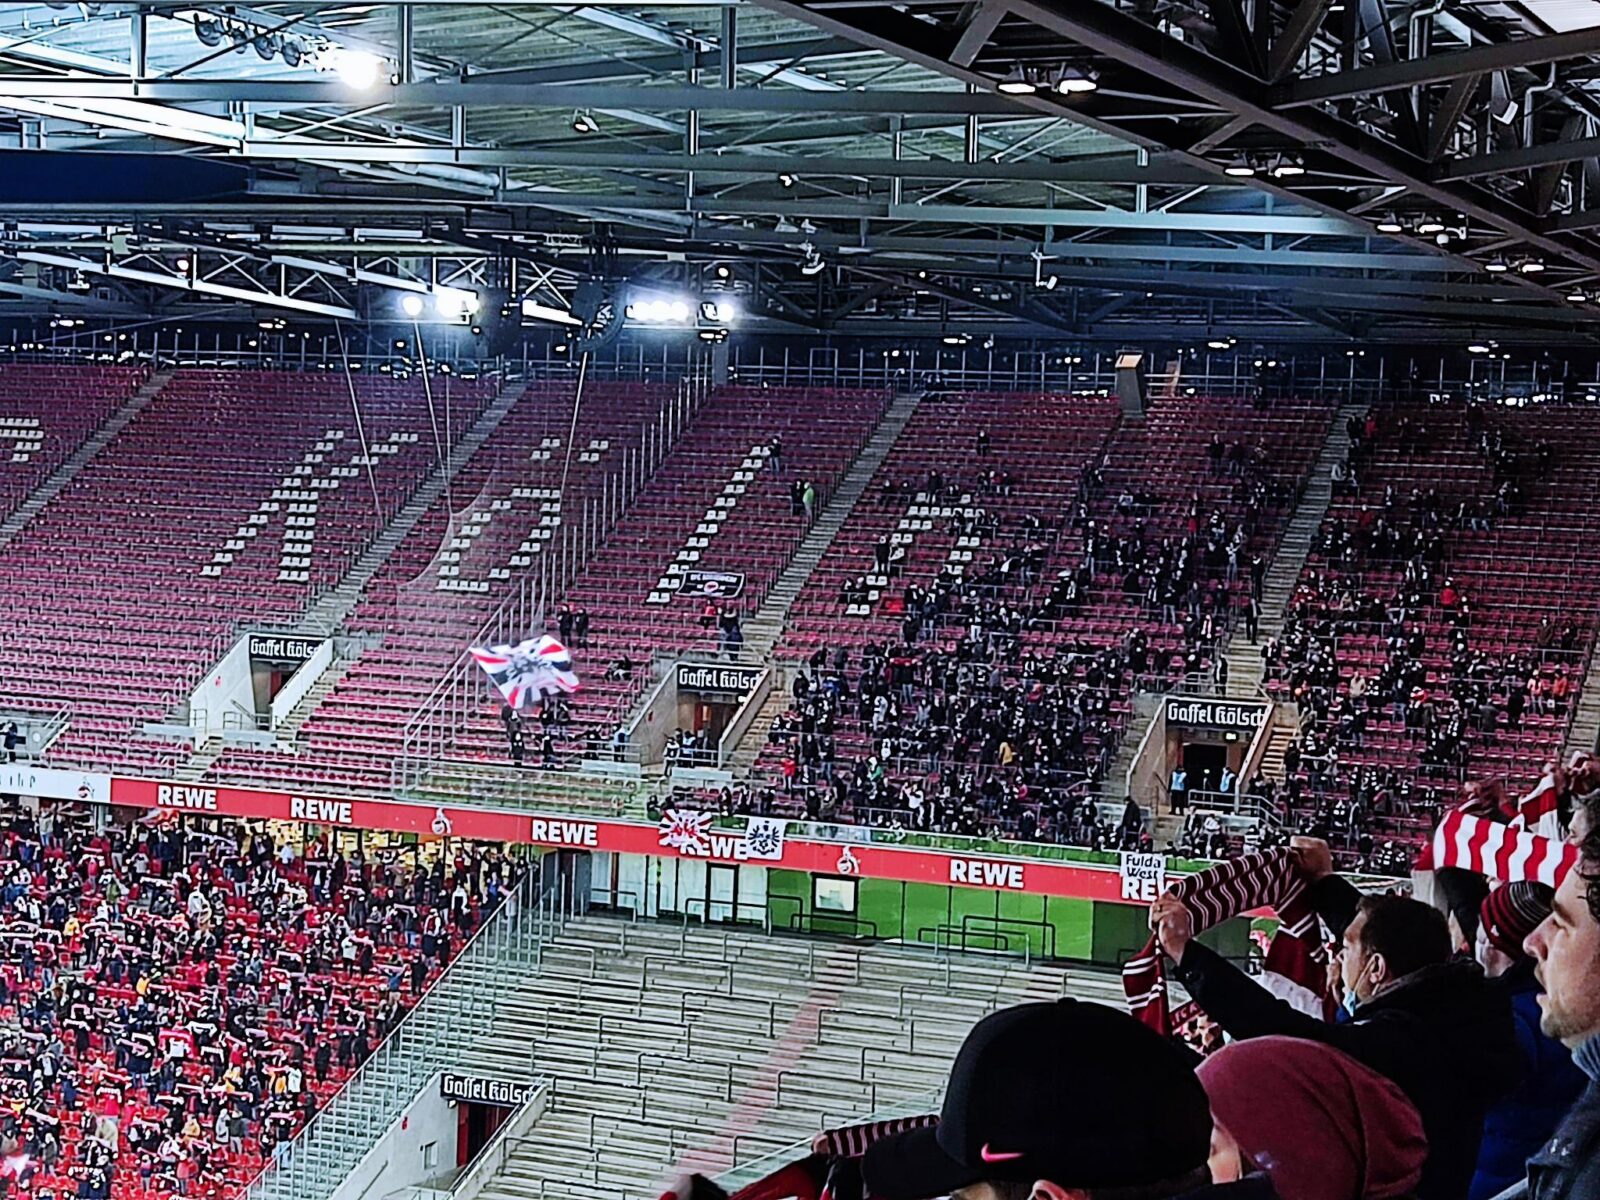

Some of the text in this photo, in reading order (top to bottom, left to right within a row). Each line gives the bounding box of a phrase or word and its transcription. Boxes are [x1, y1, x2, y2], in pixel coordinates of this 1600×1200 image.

[250, 639, 318, 658] Gaffel Köls
[679, 668, 718, 688] Gaffel
[1167, 702, 1213, 724] Gaffel
[157, 785, 218, 810] REWE
[290, 797, 353, 823] REWE
[531, 819, 599, 846] REWE
[1126, 854, 1161, 868] Fulda
[950, 859, 1025, 889] REWE
[443, 1075, 535, 1105] Gaffel Kölsc
